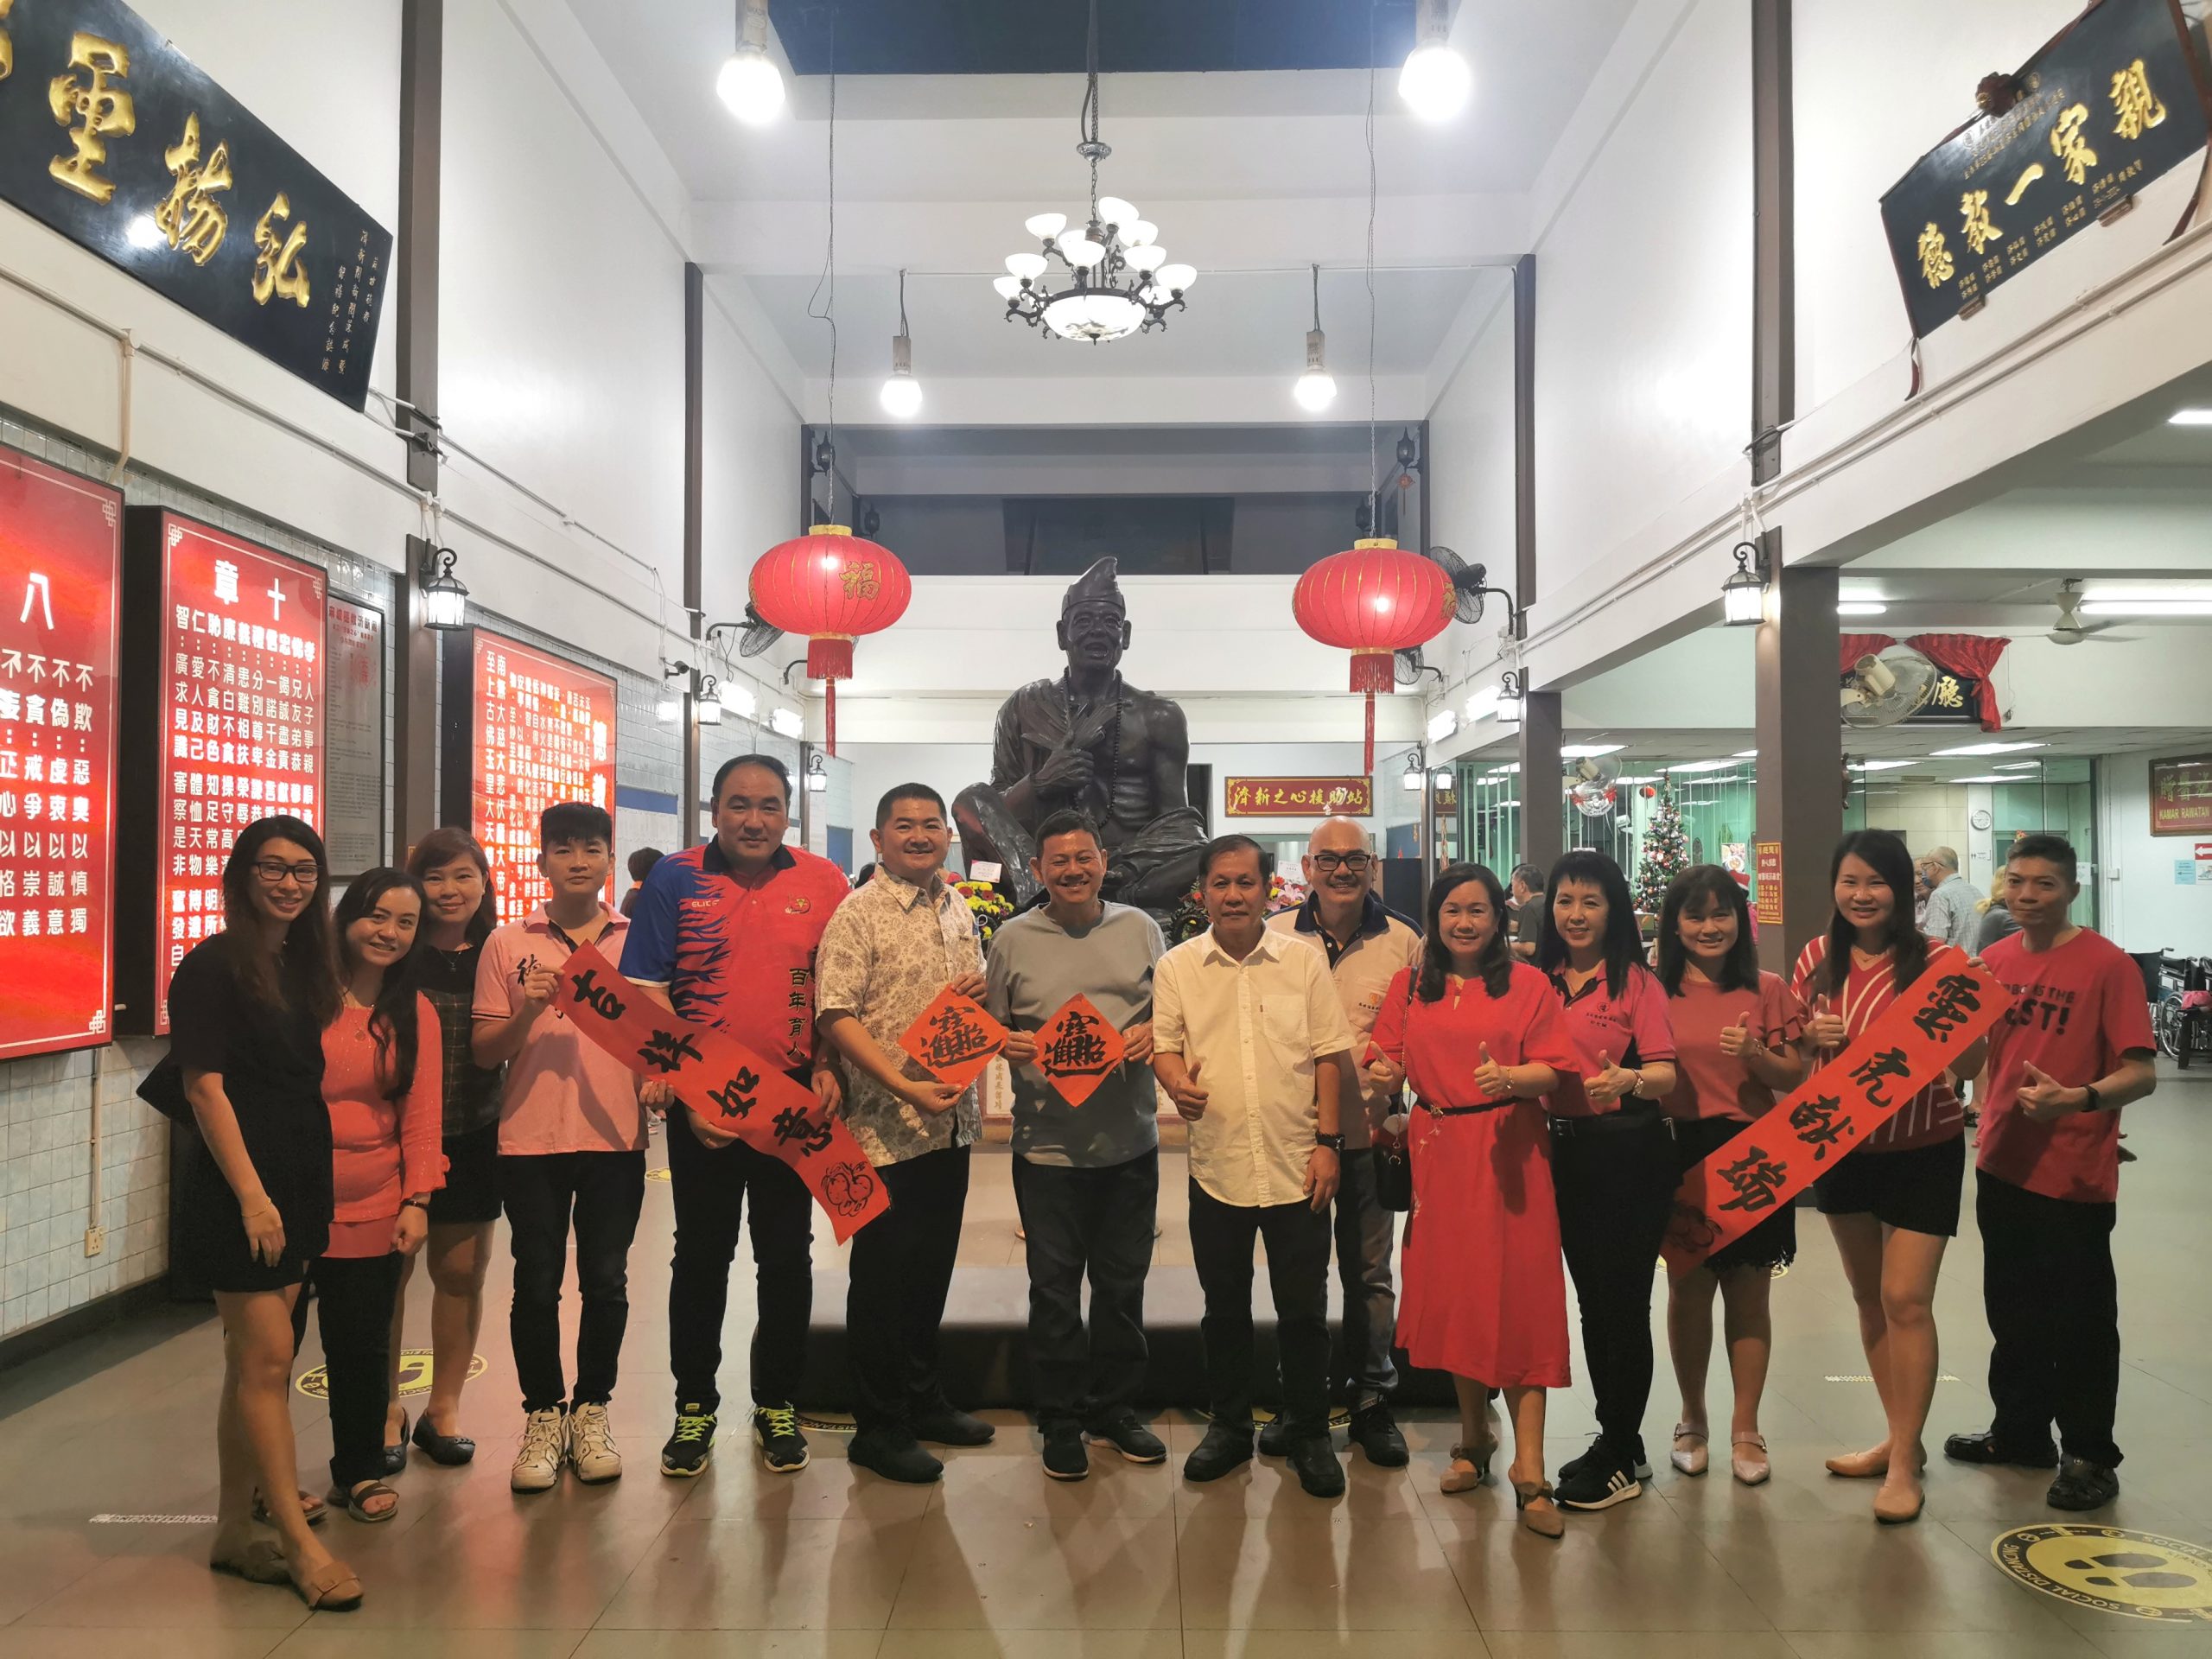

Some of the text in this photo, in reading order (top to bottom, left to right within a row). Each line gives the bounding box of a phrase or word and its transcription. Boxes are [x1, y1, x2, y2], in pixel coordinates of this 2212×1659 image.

[0, 0, 309, 308] 弘揚聖
[839, 561, 880, 601] 福
[2159, 806, 2210, 821] KAMAR RAWATAN
[786, 967, 810, 1058] 百年育人
[2049, 987, 2075, 1004] THE
[572, 969, 834, 1157] 吉祥如意
[2002, 1543, 2121, 1611] SOCIAL DISTANCING
